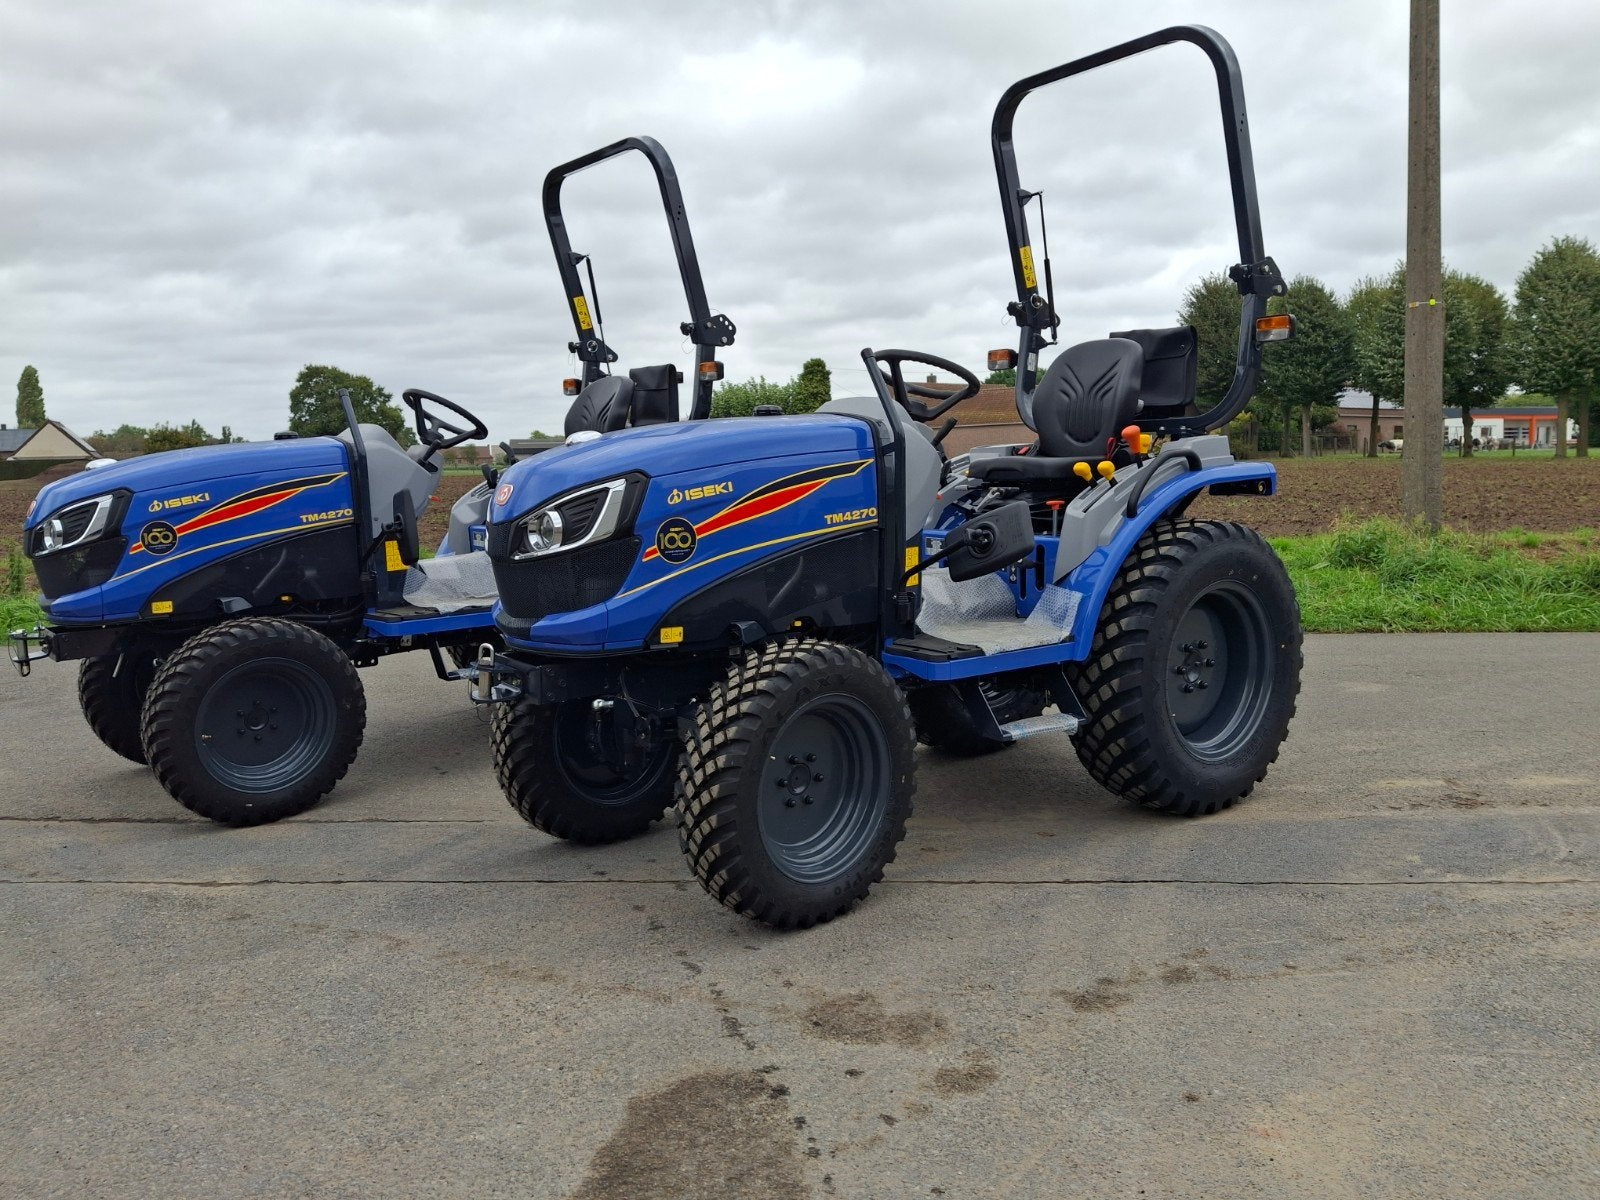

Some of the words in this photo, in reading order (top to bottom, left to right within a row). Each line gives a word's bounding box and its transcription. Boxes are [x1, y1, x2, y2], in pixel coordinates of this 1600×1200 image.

[685, 481, 733, 501] ISEKI
[164, 492, 210, 509] ISEKI
[300, 508, 353, 523] TM4270
[824, 507, 877, 524] TM4270
[142, 531, 173, 545] 100
[659, 532, 692, 549] 100
